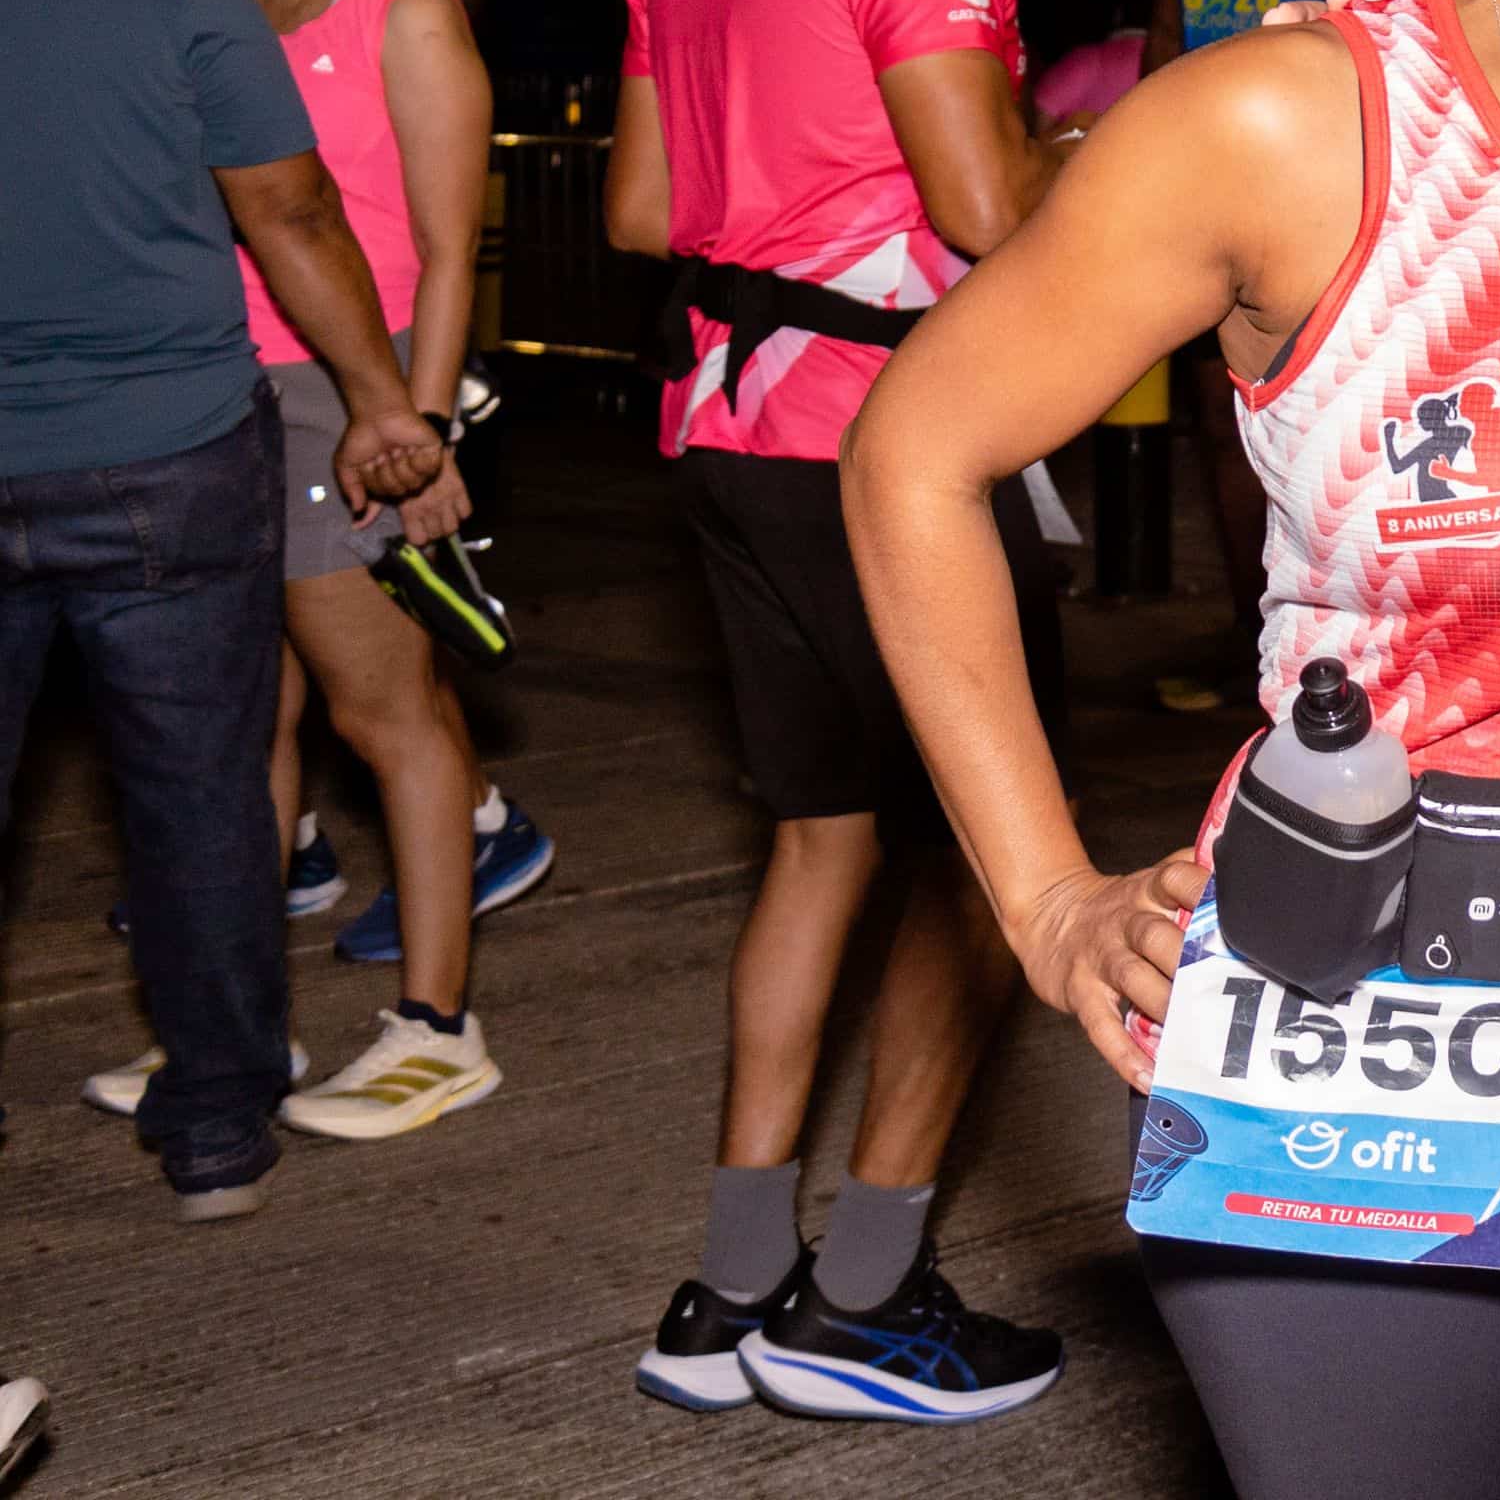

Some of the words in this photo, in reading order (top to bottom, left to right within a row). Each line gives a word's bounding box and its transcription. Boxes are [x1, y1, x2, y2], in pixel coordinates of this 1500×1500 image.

[1388, 518, 1399, 532] 8
[1351, 1130, 1438, 1173] ofit
[1260, 1200, 1323, 1222] RETIRA
[1329, 1206, 1353, 1224] TU
[1355, 1209, 1439, 1231] MEDALLA
